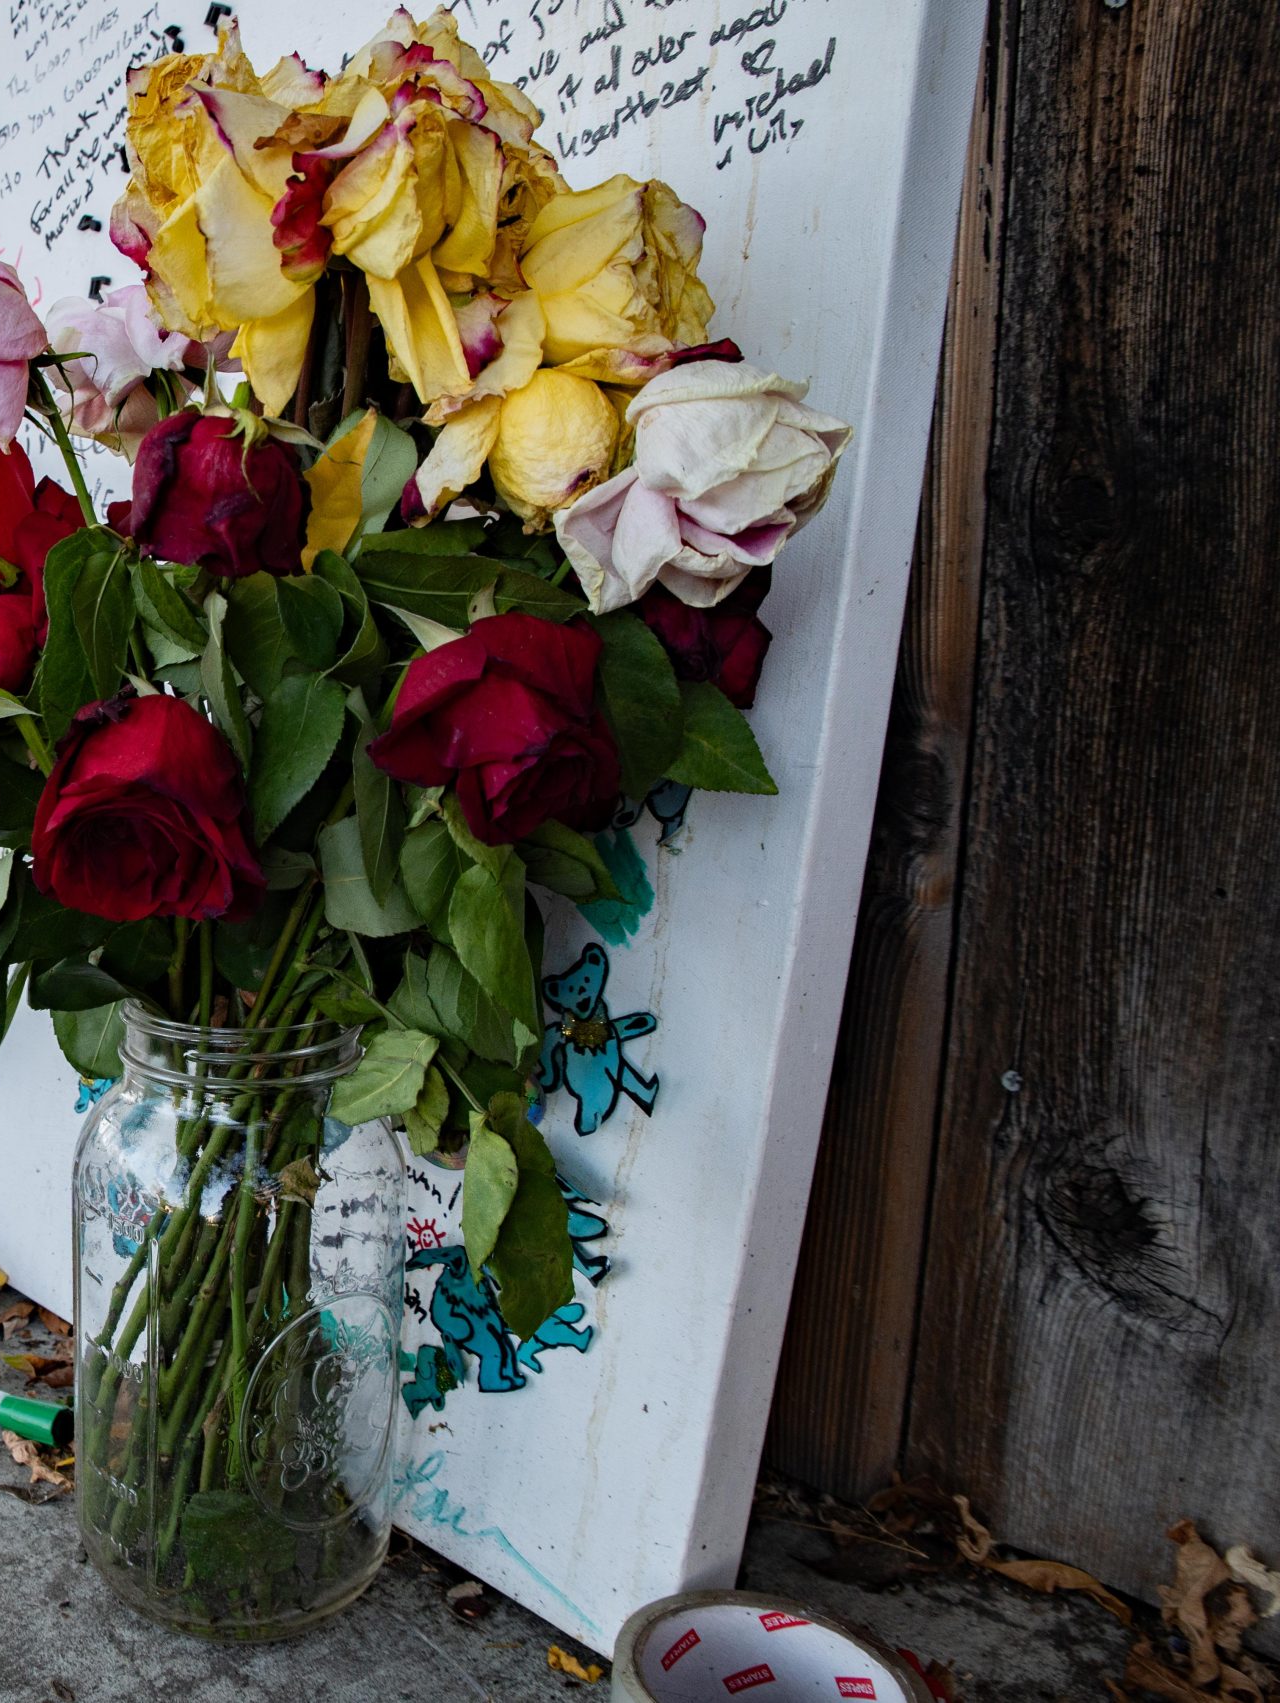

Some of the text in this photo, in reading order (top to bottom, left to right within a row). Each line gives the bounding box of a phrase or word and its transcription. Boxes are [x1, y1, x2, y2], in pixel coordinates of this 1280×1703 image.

[513, 49, 560, 91] ove
[36, 110, 98, 180] Thank
[663, 1632, 697, 1668] STAPLES
[727, 1667, 771, 1689] STAPLES
[839, 1680, 875, 1697] STAPLES
